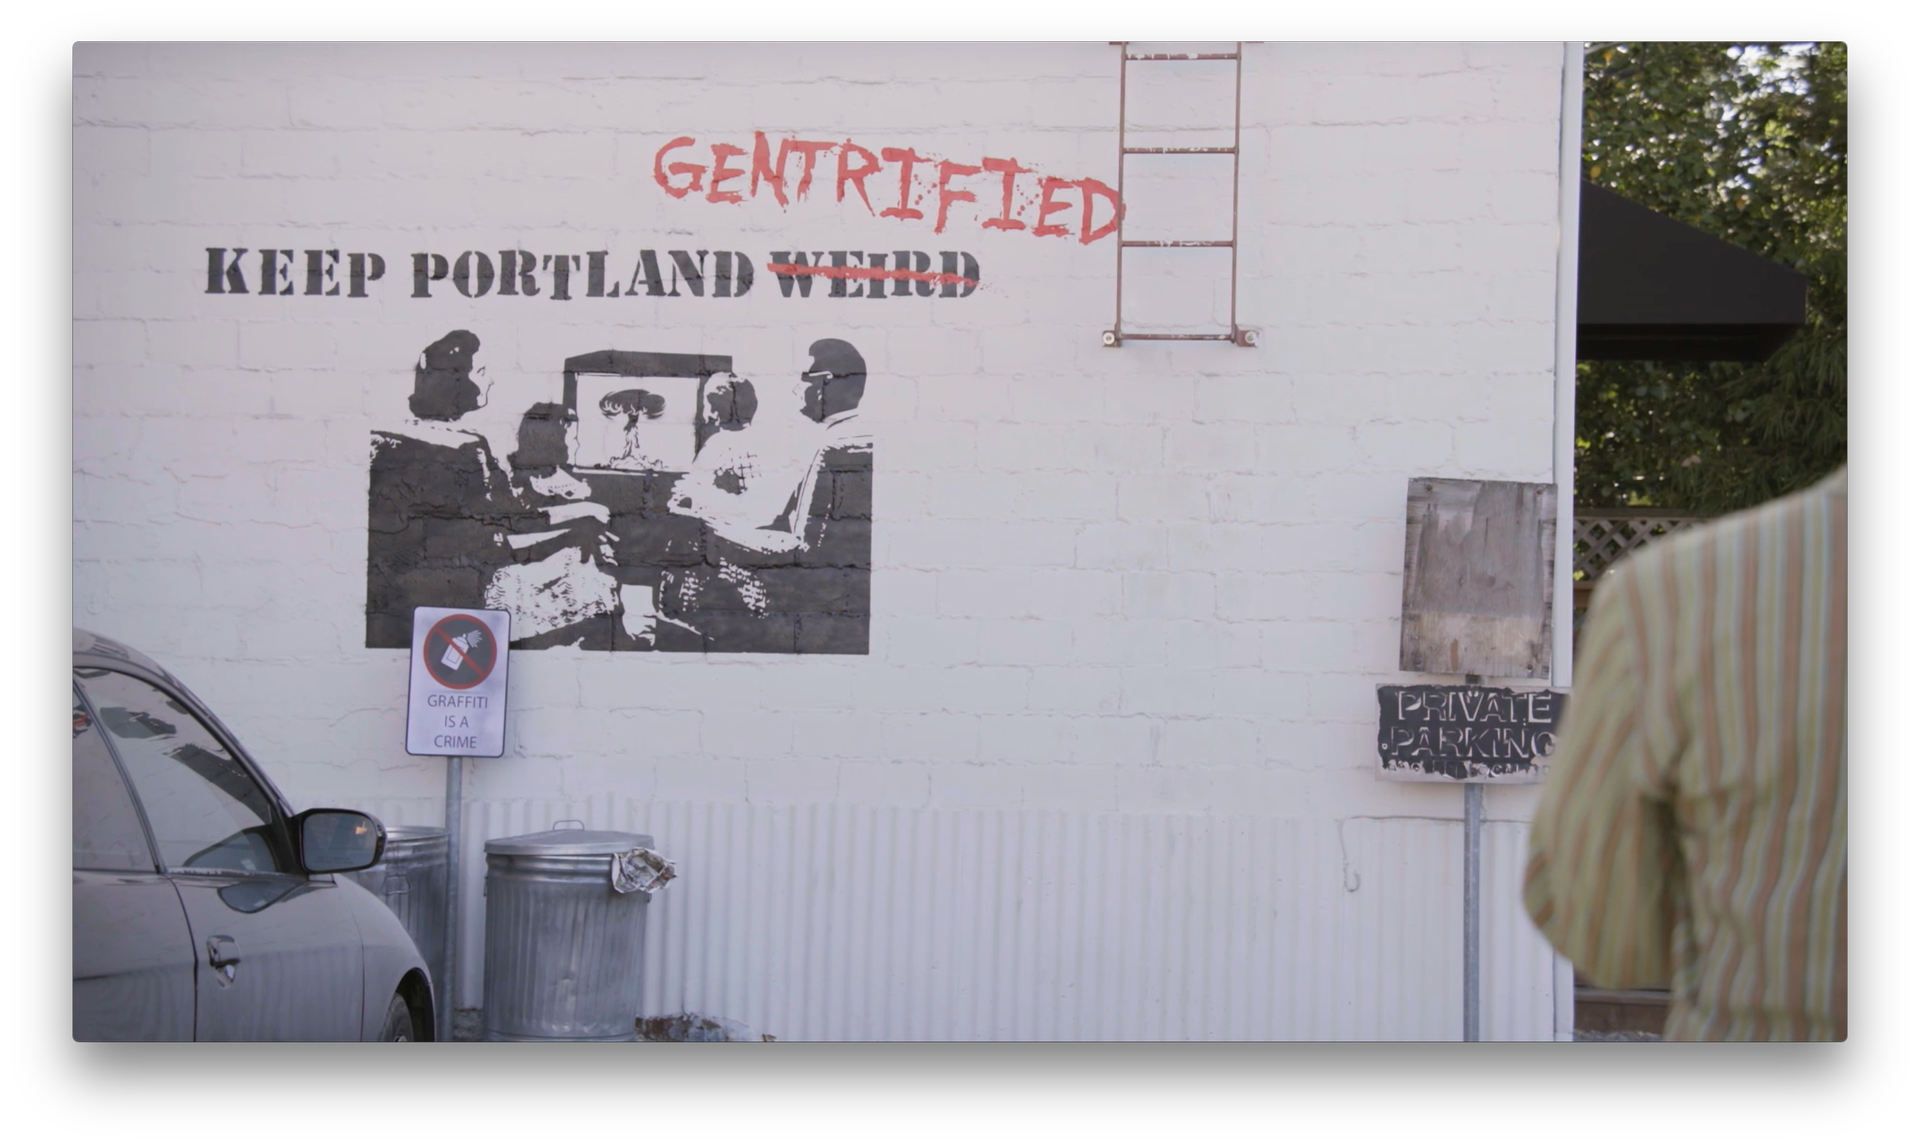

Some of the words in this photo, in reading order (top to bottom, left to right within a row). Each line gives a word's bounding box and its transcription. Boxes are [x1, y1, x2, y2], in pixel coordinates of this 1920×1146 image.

[654, 130, 1126, 246] GENTRIFIED
[204, 247, 386, 298] KEEP
[411, 249, 755, 301] PORTLAND
[768, 250, 981, 299] WEIRD
[427, 694, 488, 709] GRAFFITI
[1395, 690, 1552, 723] PRIVATE
[444, 715, 456, 728] IS
[459, 715, 469, 728] A
[434, 734, 477, 749] CRIME
